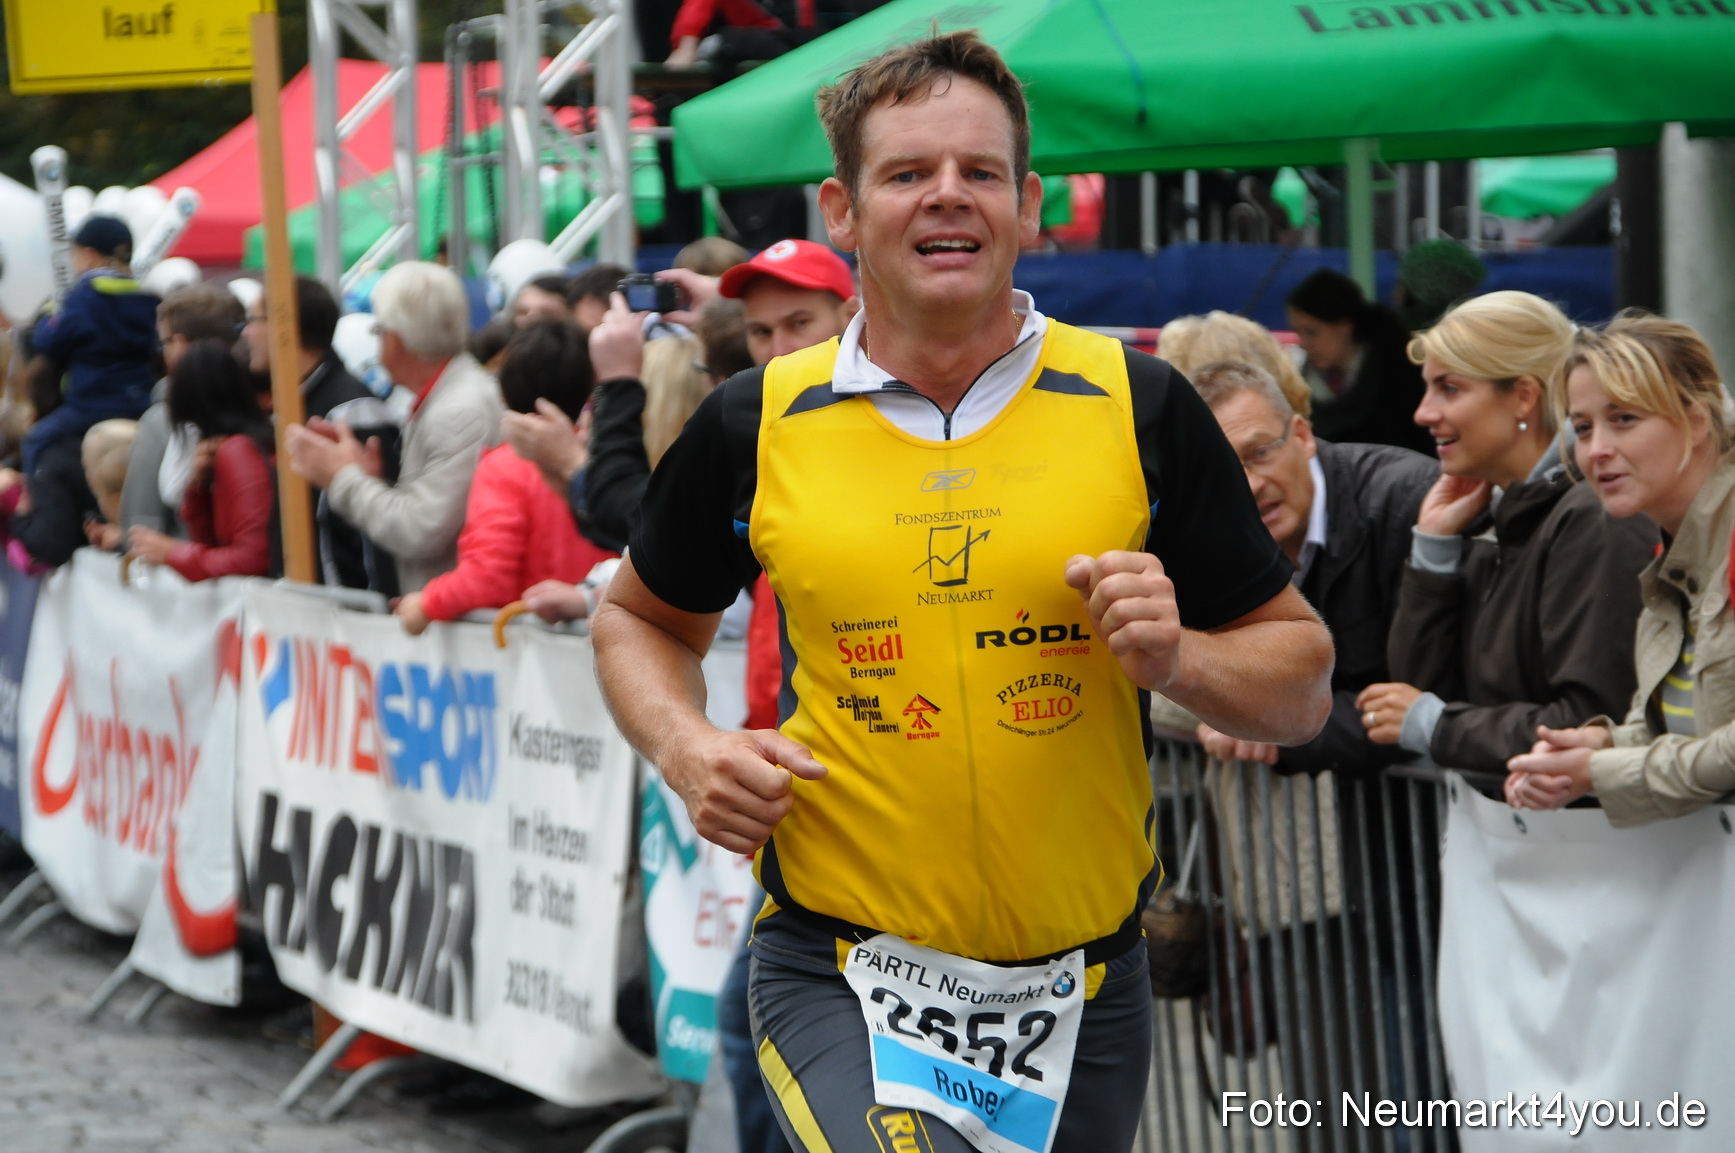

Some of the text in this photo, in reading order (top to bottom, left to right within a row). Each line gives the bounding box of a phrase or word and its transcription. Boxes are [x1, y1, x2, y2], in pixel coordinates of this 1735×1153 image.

[102, 3, 176, 40] lauf
[831, 615, 898, 633] Schreinerei
[837, 633, 904, 665] Seidl
[1039, 640, 1091, 658] energie
[849, 666, 897, 680] Berngau
[995, 672, 1083, 706] PIZZERIA
[1011, 695, 1074, 723] ELIO
[938, 973, 1045, 1005] Neumarkt
[870, 986, 1057, 1083] 2652
